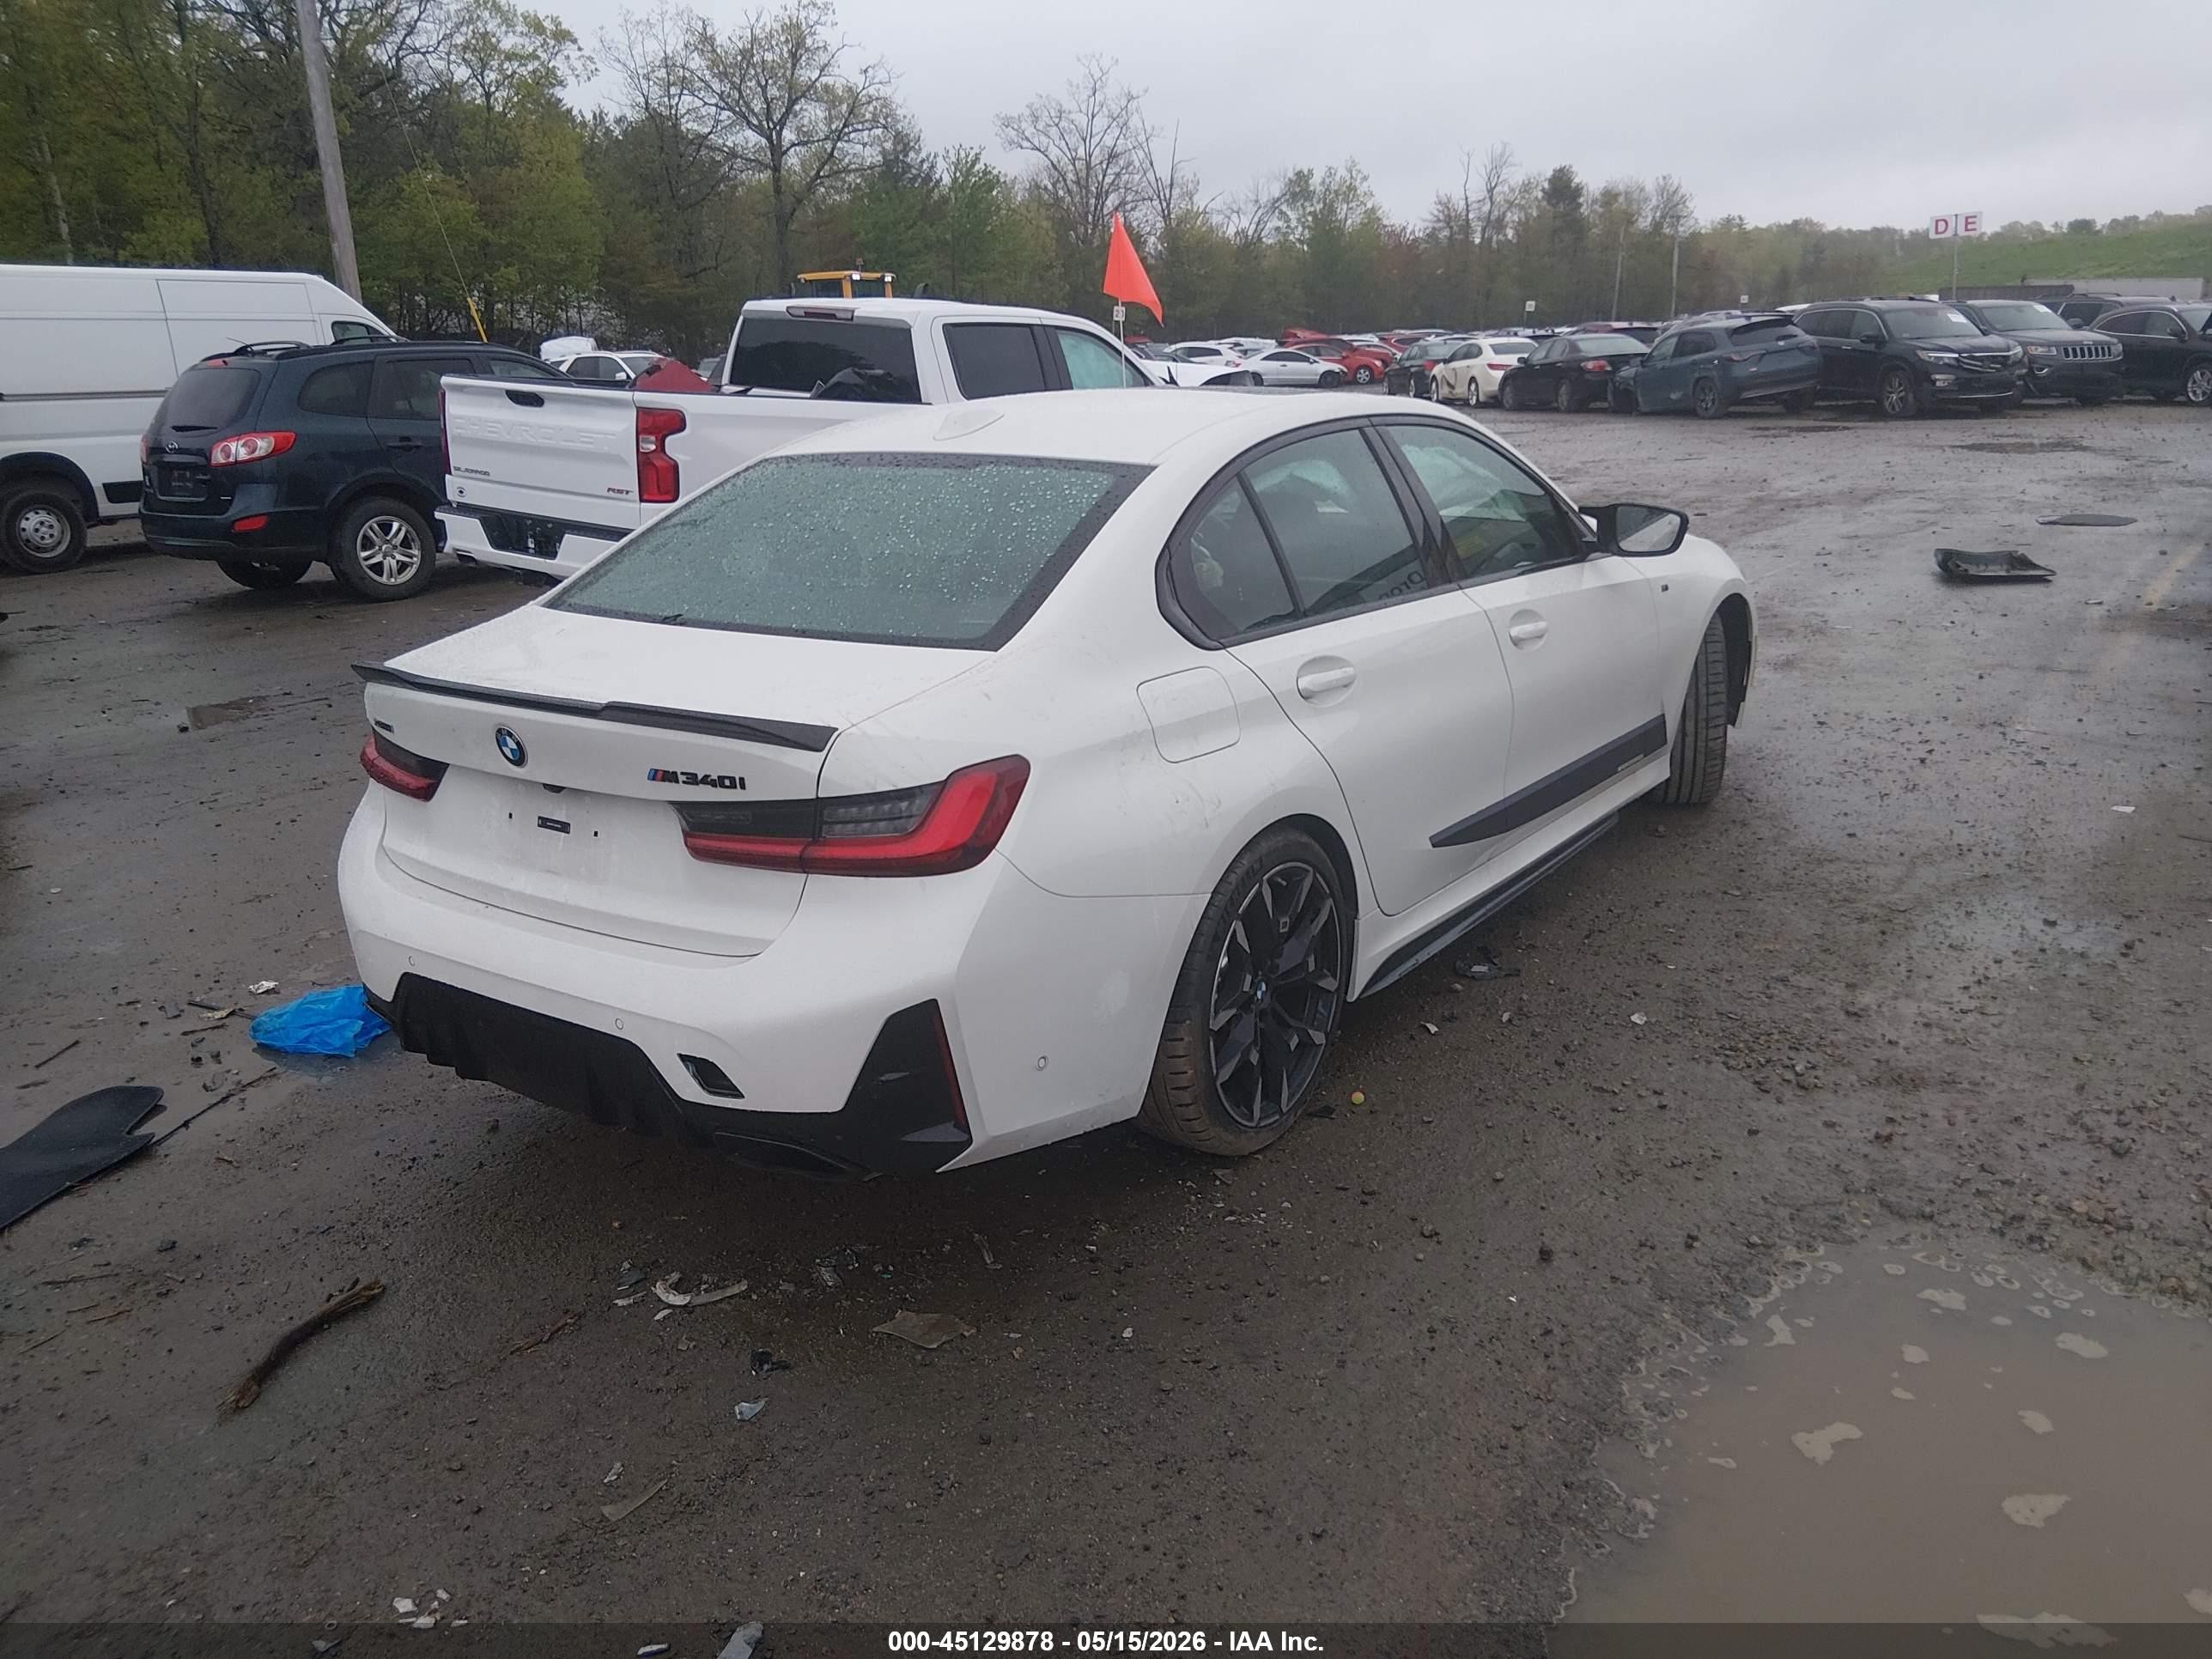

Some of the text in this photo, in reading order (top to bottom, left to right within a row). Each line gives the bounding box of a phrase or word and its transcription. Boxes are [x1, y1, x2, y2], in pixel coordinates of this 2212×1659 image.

[1935, 218, 1949, 235] D
[1964, 215, 1978, 232] E
[606, 487, 635, 495] RST
